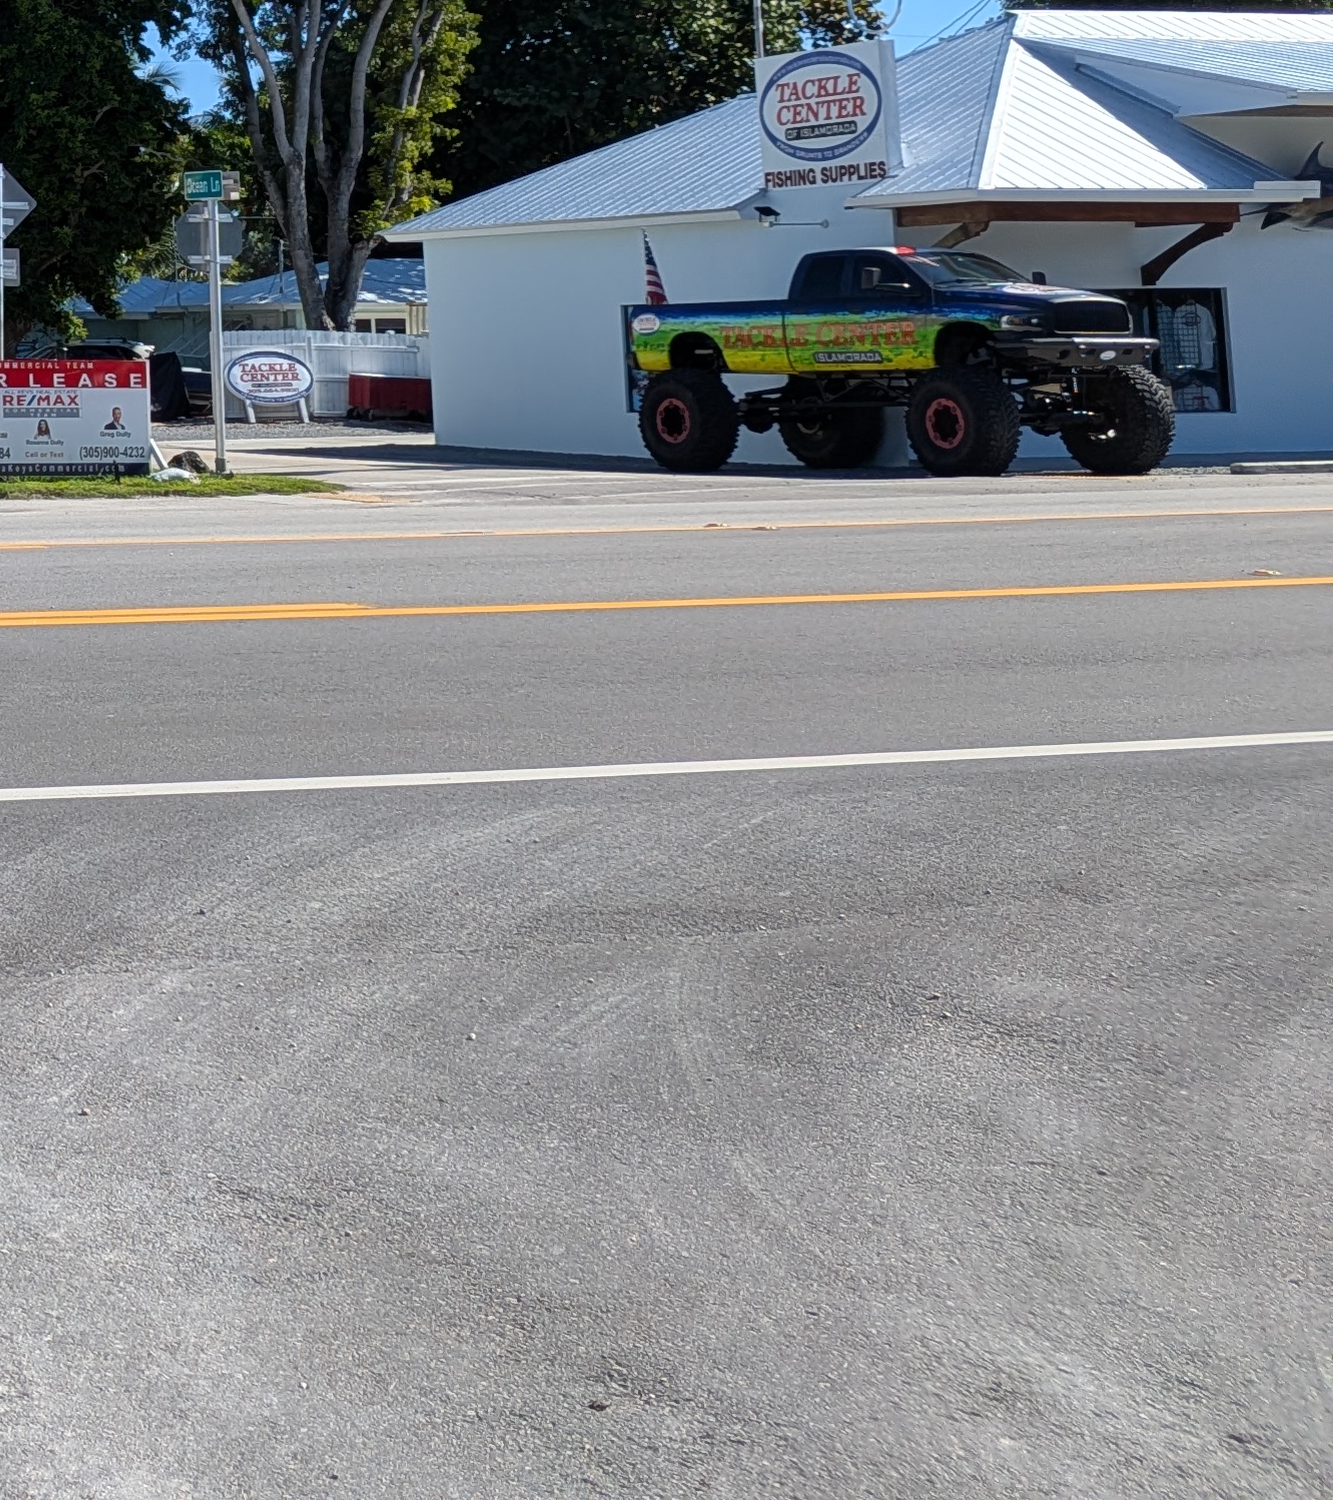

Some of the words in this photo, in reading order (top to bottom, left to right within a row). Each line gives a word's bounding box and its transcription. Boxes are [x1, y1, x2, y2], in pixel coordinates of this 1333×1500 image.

[775, 72, 862, 104] TACKLE
[776, 96, 867, 126] CENTER
[800, 122, 856, 137] ISLAMORADA
[764, 167, 817, 188] FISHING
[820, 160, 887, 184] SUPPLIES
[187, 178, 208, 194] Ocean
[210, 176, 220, 192] Ln
[719, 324, 809, 349] TACKLE
[815, 320, 919, 347] CENTER
[814, 352, 882, 363] ISLAMORADA
[238, 363, 298, 373] TACKLE
[28, 373, 143, 388] LEASE
[239, 372, 302, 382] CENTER
[2, 394, 79, 407] RE/MAX
[79, 446, 145, 461] (305)900-4232
